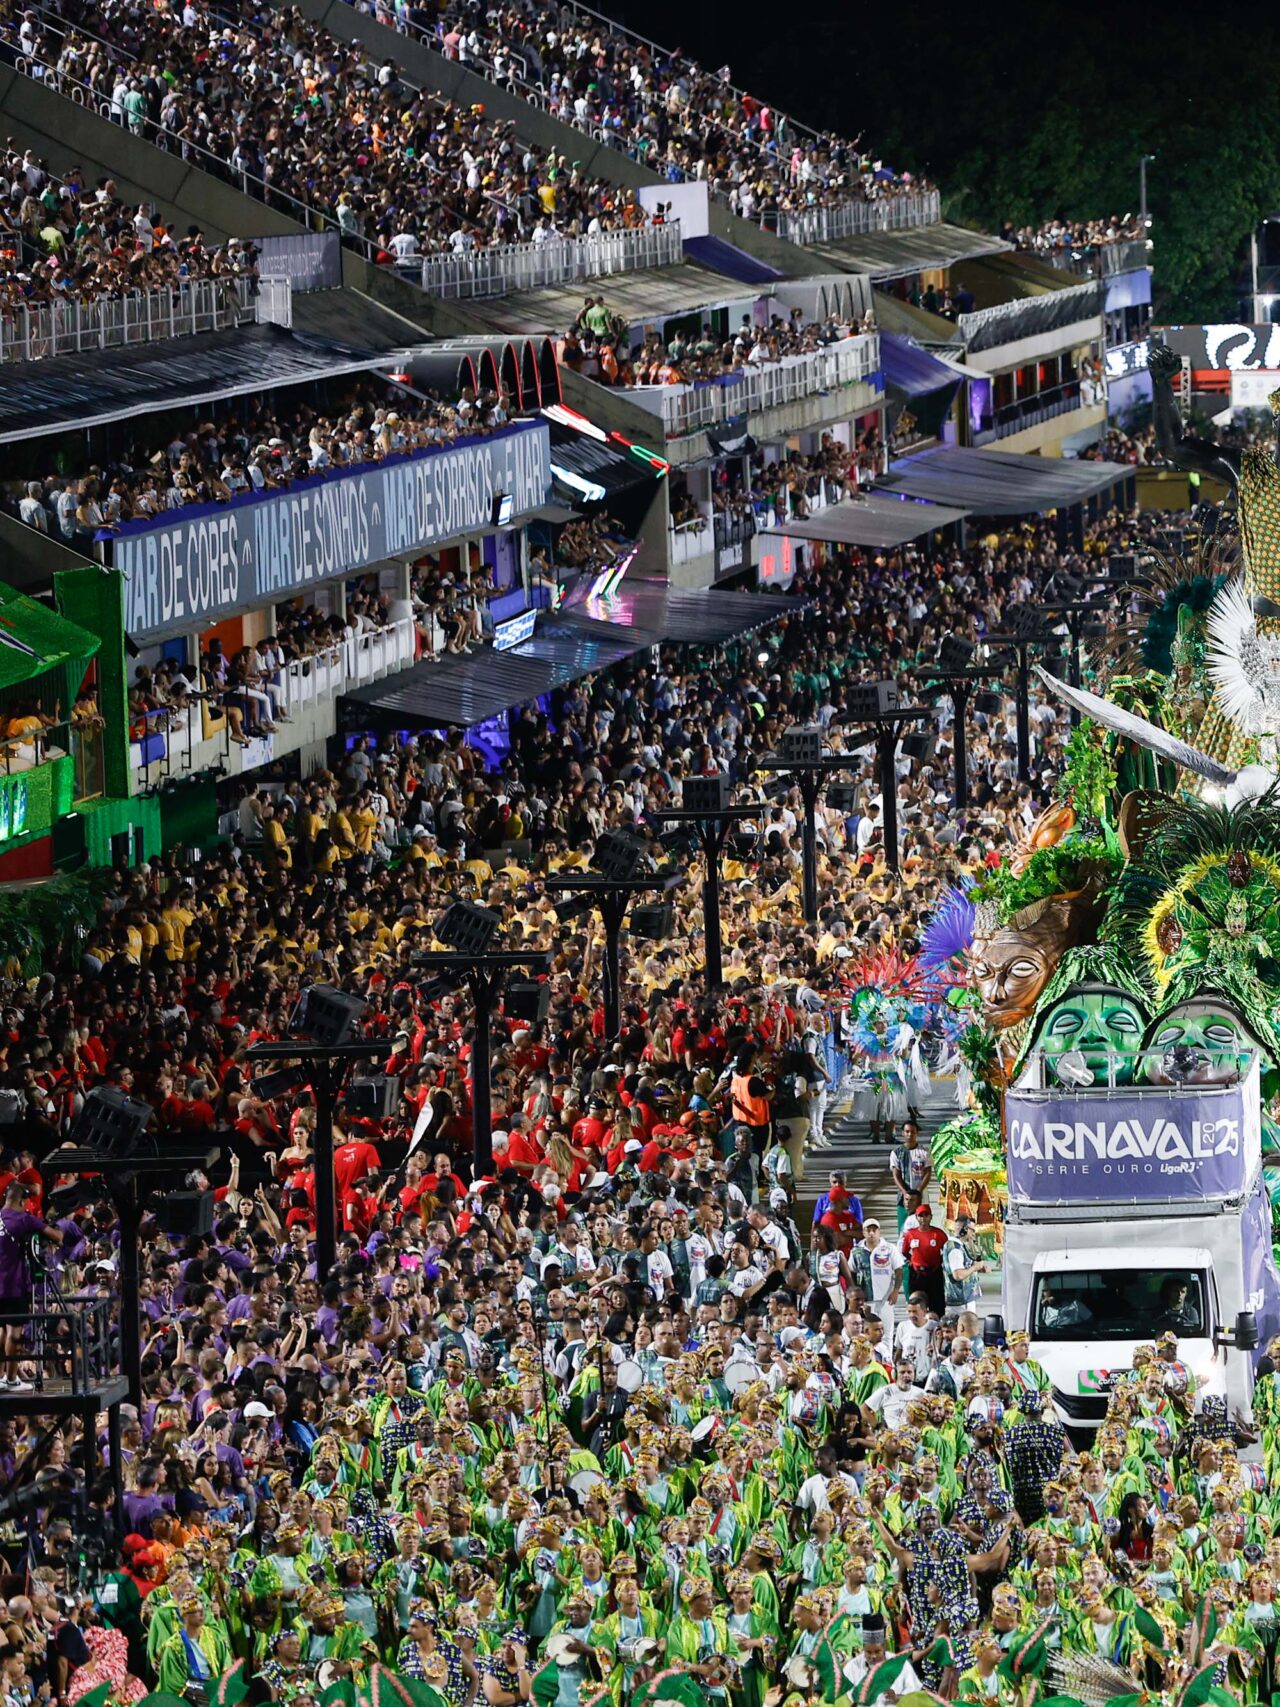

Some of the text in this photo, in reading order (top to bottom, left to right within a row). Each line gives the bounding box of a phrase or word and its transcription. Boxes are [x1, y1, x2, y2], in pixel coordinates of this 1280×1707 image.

[160, 529, 184, 621] DE
[187, 514, 239, 614] CORES
[254, 500, 293, 595] MAR
[291, 496, 313, 582] DE
[314, 479, 369, 577] SONHOS
[383, 465, 416, 552] MAR
[416, 462, 433, 541] DE
[434, 447, 493, 536] SORRISOS
[1010, 1118, 1214, 1160] CARNAVAL
[1103, 1163, 1154, 1174] OURO
